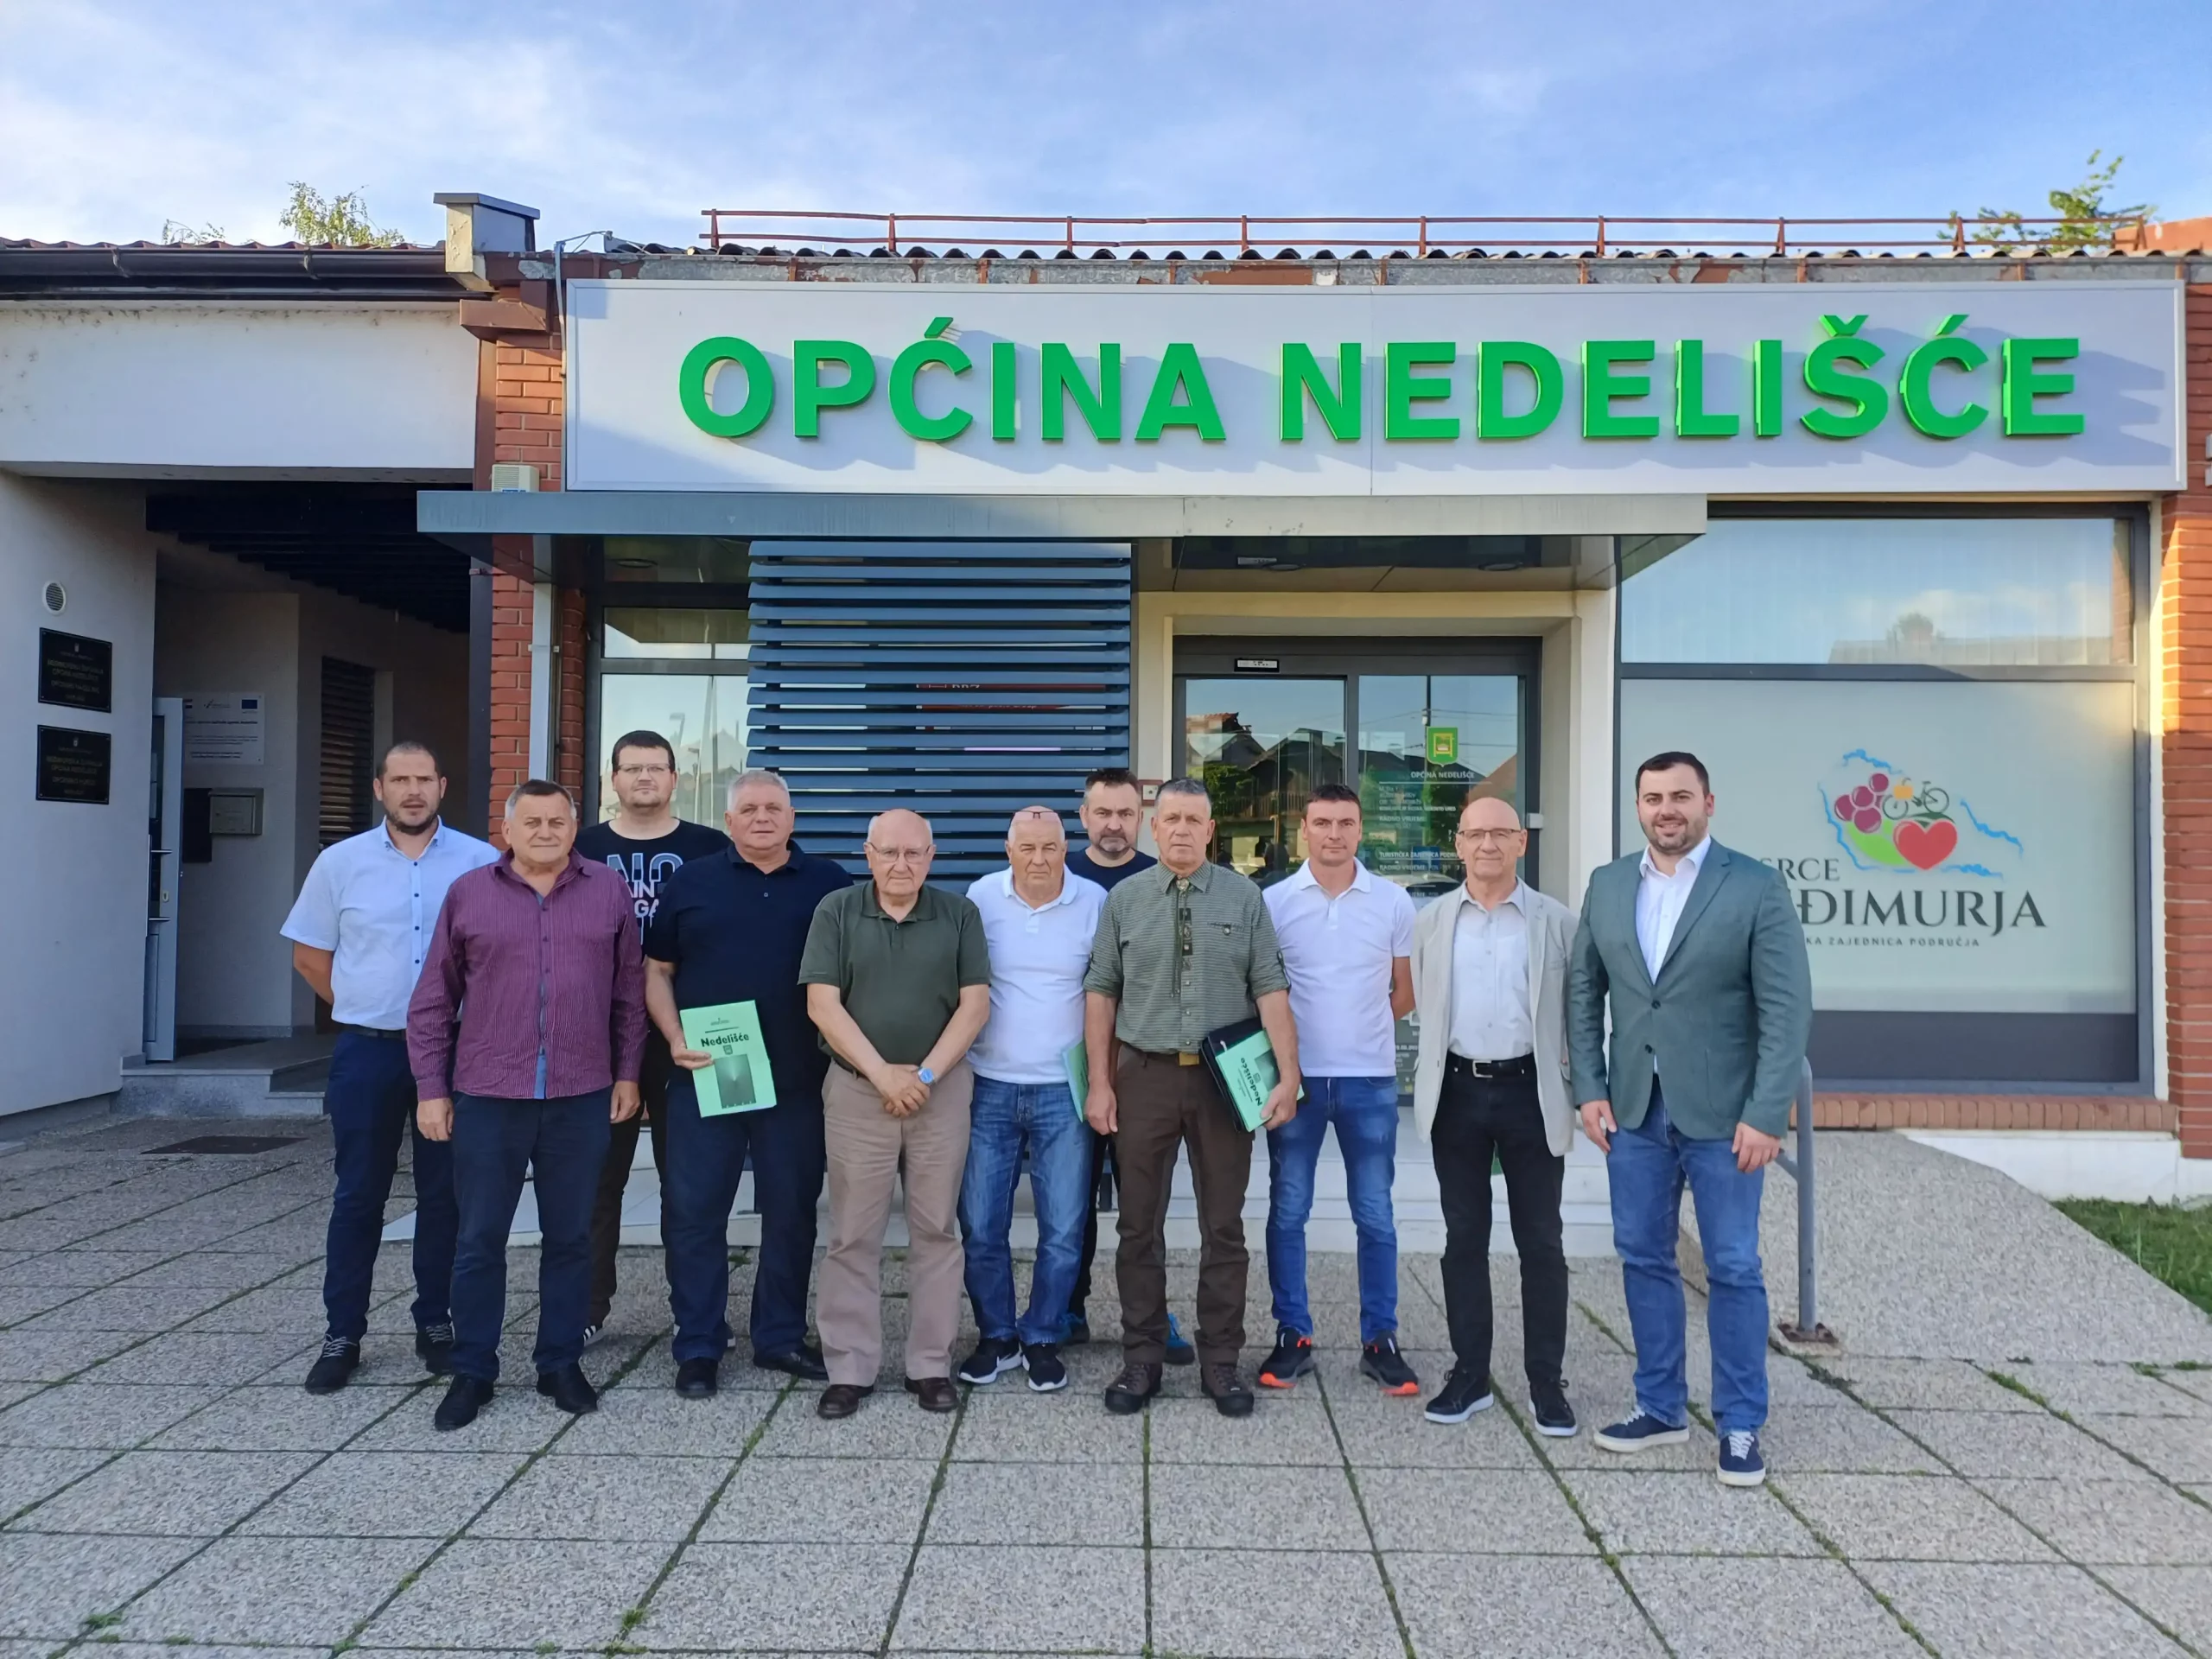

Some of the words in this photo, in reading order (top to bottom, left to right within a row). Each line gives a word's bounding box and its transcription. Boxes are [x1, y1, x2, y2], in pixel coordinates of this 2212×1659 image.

[679, 316, 1227, 442] OPĆINA
[1280, 314, 2084, 442] NEDELIŠĆE
[1760, 857, 1840, 881] RCE
[1796, 888, 2048, 938] ĐIMURJA
[1828, 937, 1904, 947] ZAJEDNICA
[701, 1033, 750, 1047] Nedelišće
